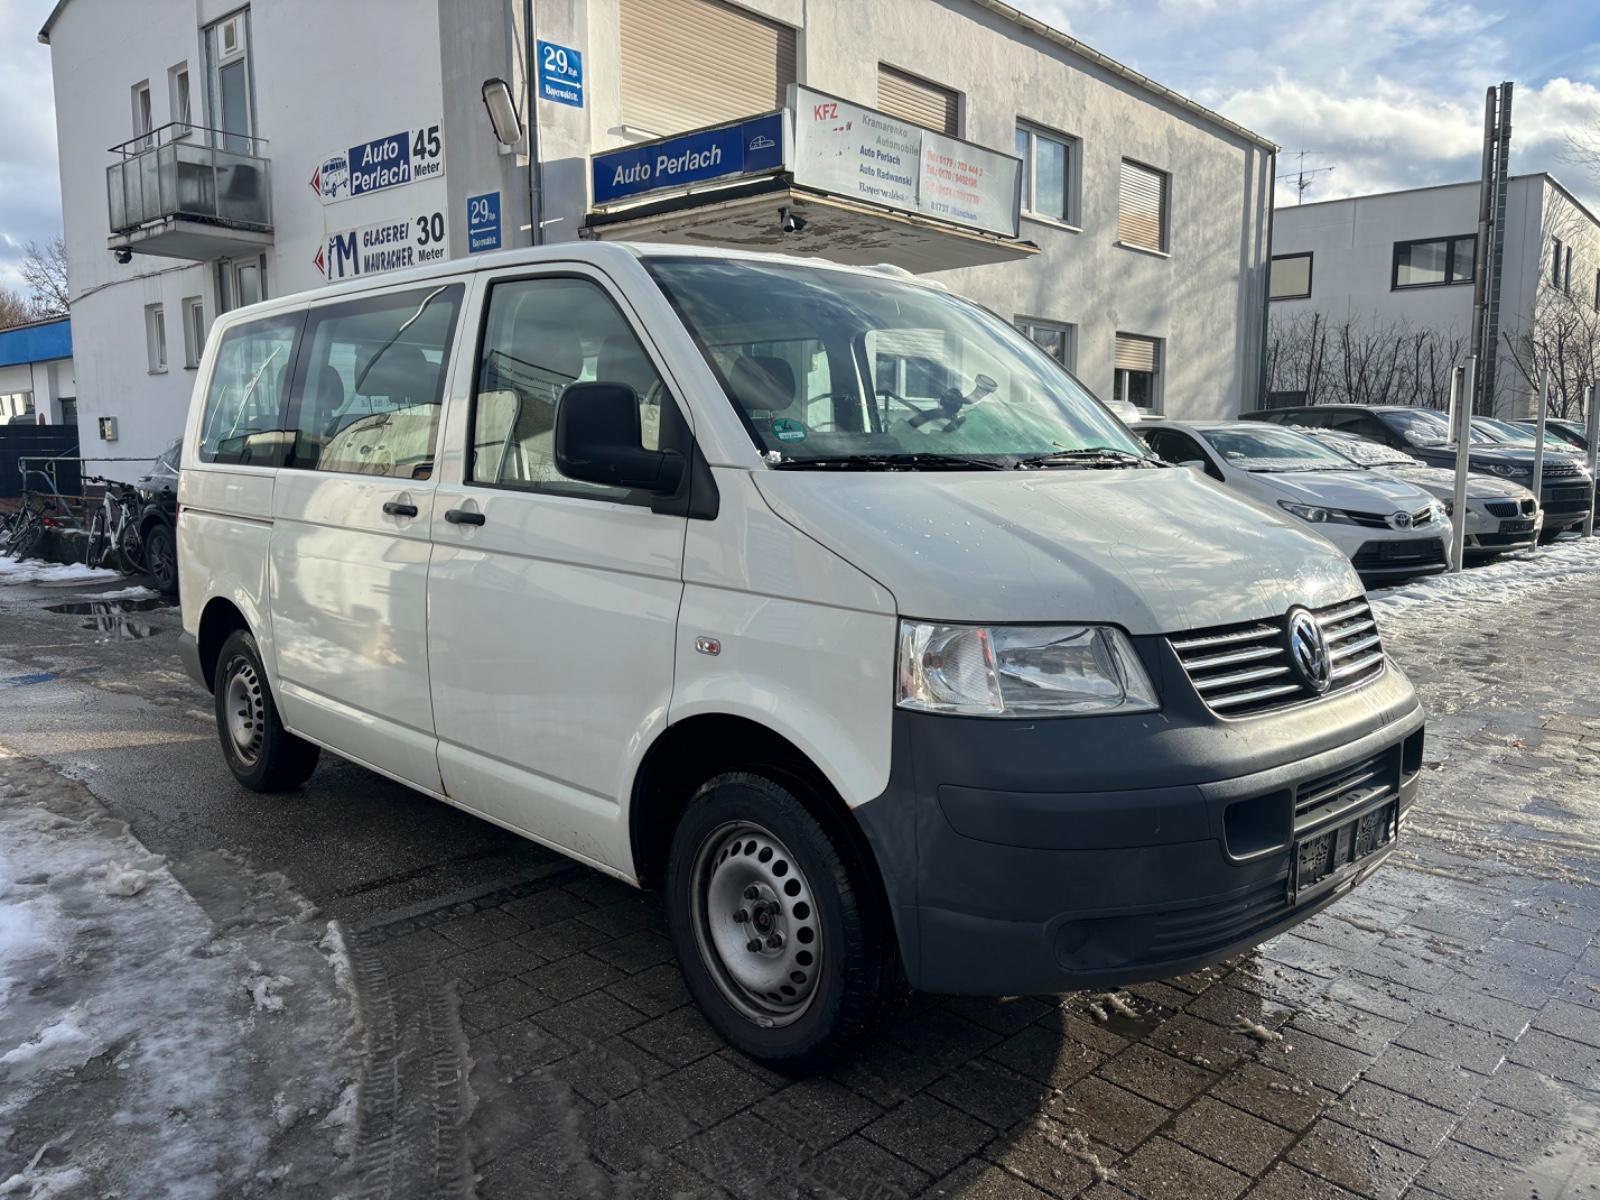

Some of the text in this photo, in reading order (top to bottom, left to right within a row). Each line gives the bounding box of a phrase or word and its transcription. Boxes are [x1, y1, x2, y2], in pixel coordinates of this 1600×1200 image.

[543, 46, 568, 74] 29
[813, 102, 839, 121] KFZ
[862, 114, 908, 138] Kramarenko
[361, 141, 399, 167] Auto
[413, 125, 441, 160] 45
[612, 144, 721, 186] Auto Perlach
[860, 145, 901, 166] Auto Perlach
[351, 161, 409, 193] Perlach
[414, 162, 440, 177] Meter
[859, 163, 912, 186] Auto Radwanski
[472, 199, 488, 223] 29
[363, 222, 410, 248] GLASEREI
[416, 212, 445, 246] 30
[418, 247, 445, 262] Meter
